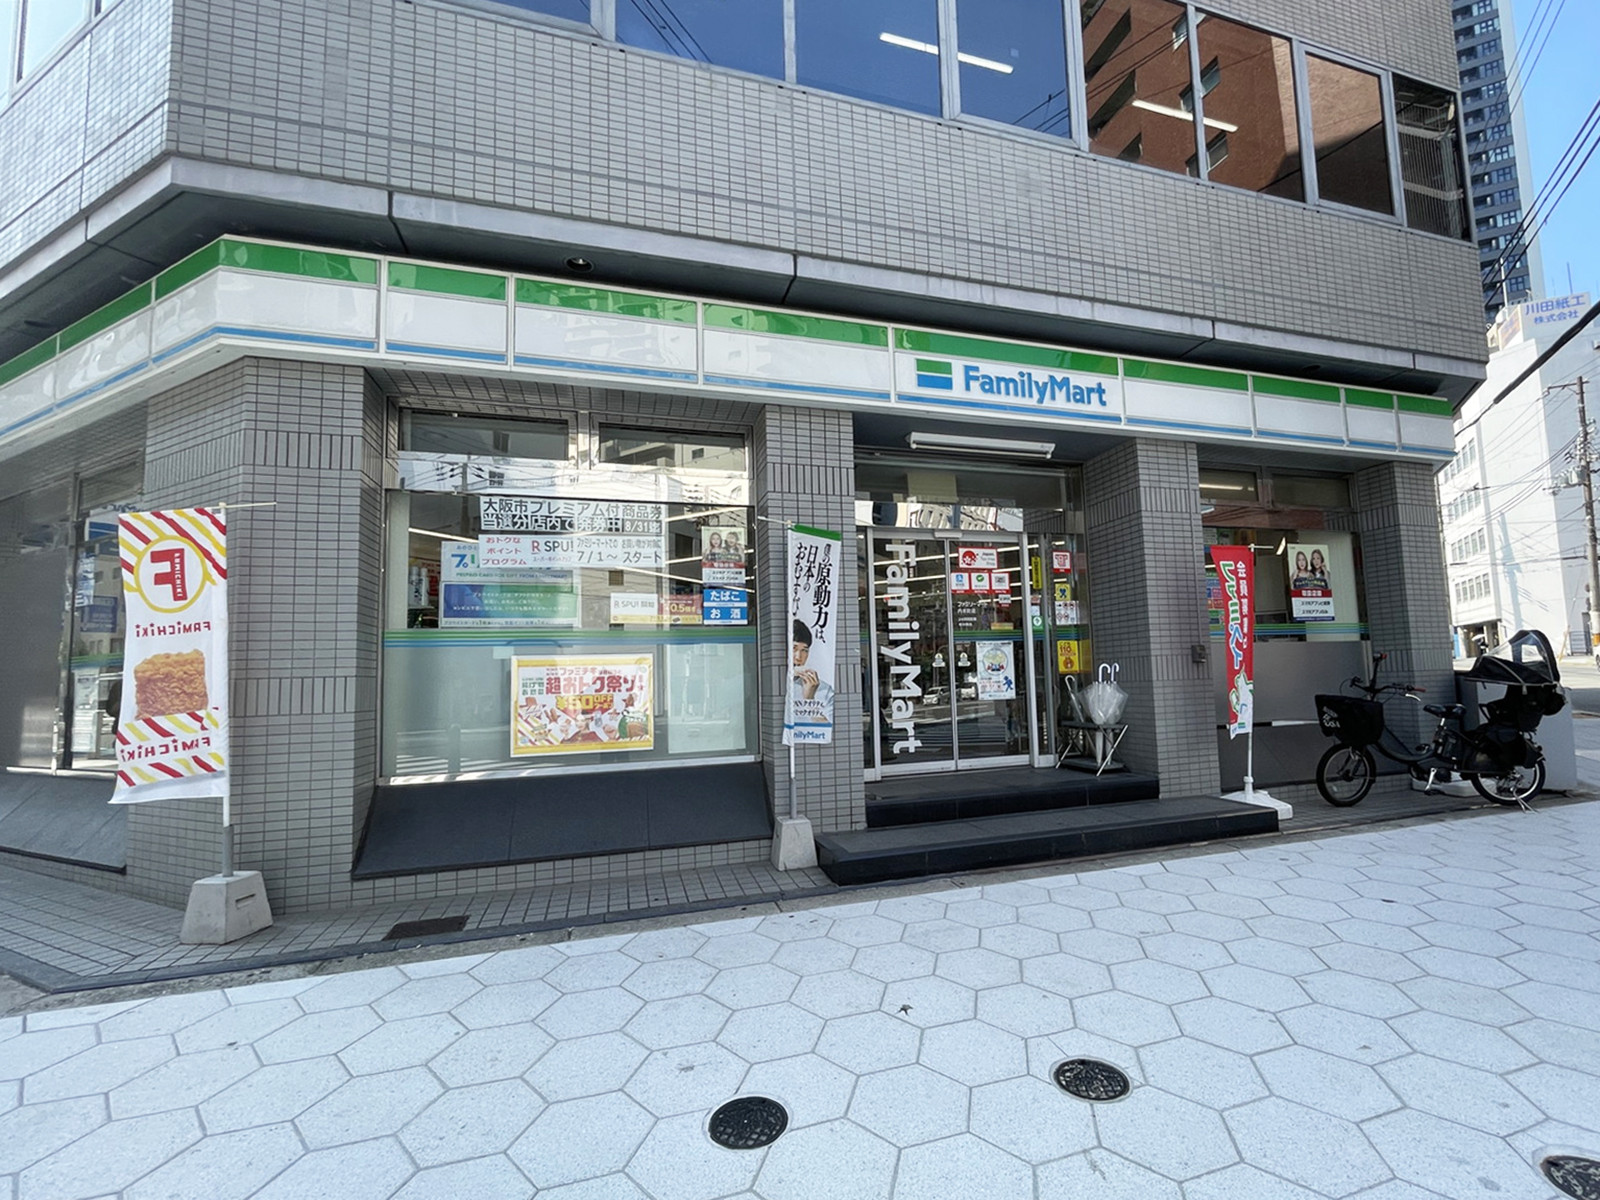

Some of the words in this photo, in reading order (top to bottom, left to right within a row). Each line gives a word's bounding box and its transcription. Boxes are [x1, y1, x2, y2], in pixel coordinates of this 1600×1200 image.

[1525, 294, 1586, 315] 川田紙工
[1534, 310, 1579, 324] 株式会社
[963, 365, 1107, 406] FamilyMart
[483, 498, 662, 519] 大阪市プレミアム付商品券
[544, 541, 574, 553] SPU!
[622, 551, 662, 564] スタート
[803, 544, 819, 593] 日本の
[710, 590, 740, 601] たばこ
[880, 544, 923, 755] FamilyMart
